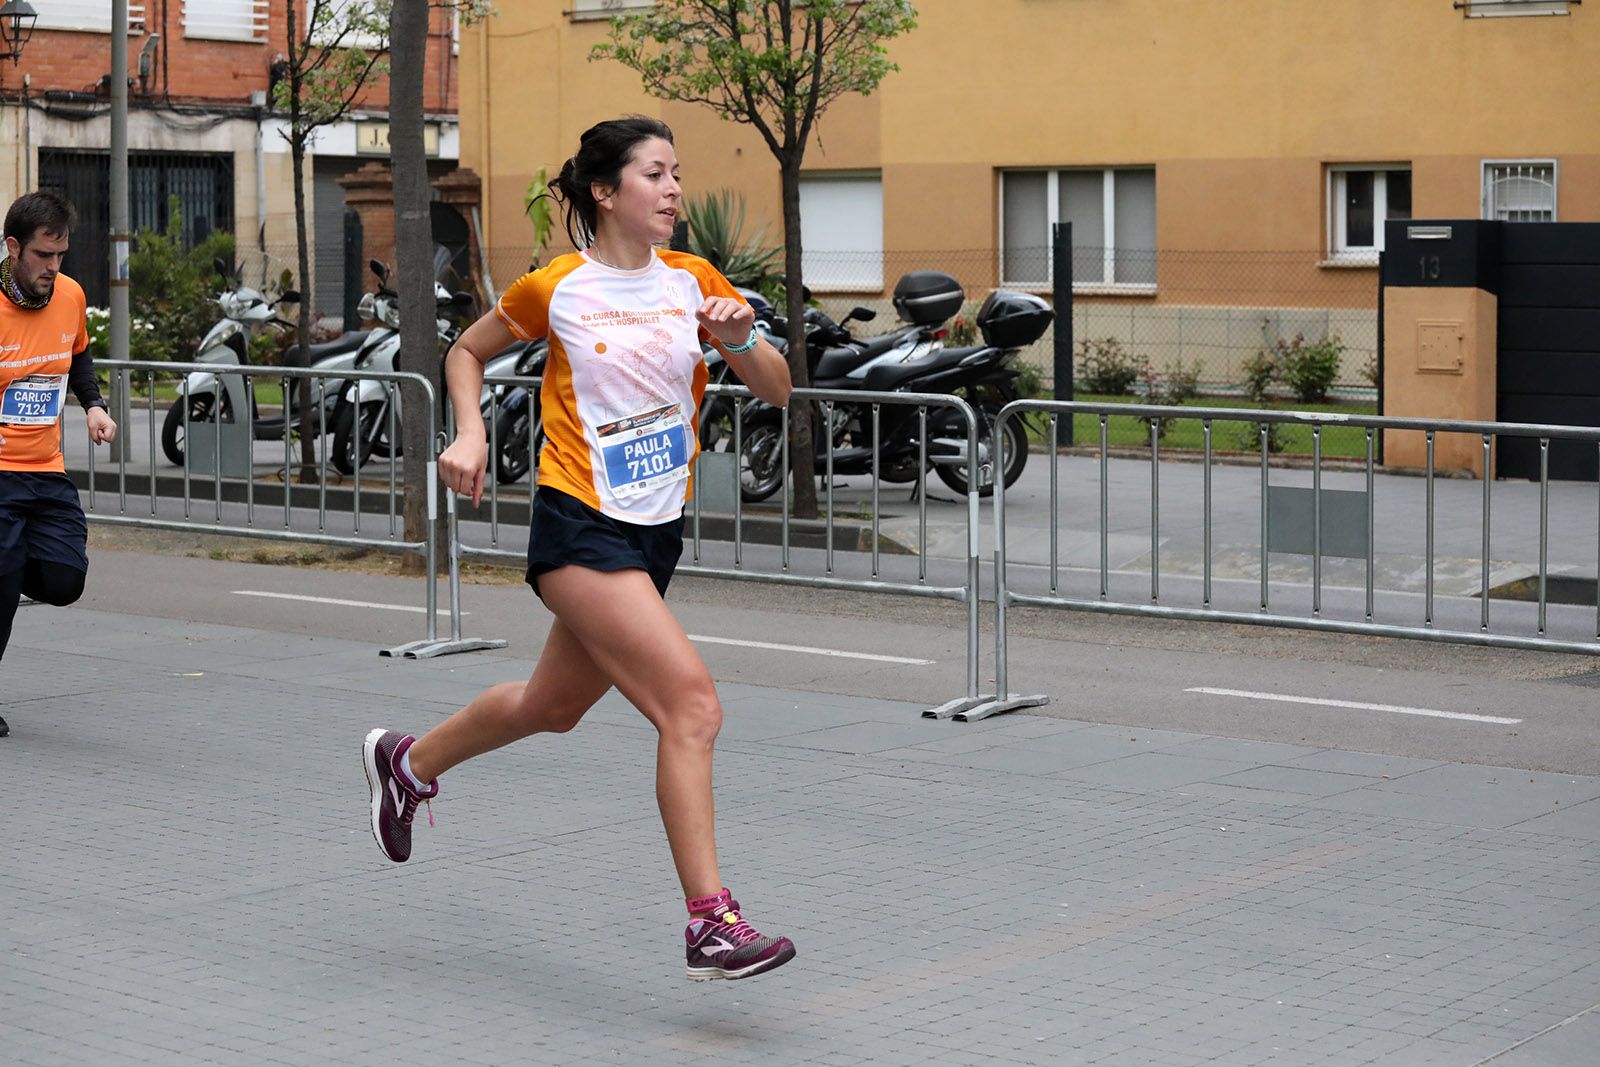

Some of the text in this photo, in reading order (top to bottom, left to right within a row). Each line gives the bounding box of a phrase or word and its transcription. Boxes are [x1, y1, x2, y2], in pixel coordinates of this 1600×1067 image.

[1419, 256, 1440, 280] 13
[593, 310, 620, 321] CURSA
[609, 316, 661, 327] L'HOSPITALET
[14, 391, 52, 402] CARLOS
[17, 402, 46, 415] 7124
[624, 433, 673, 460] PAULA
[627, 451, 674, 480] 7101
